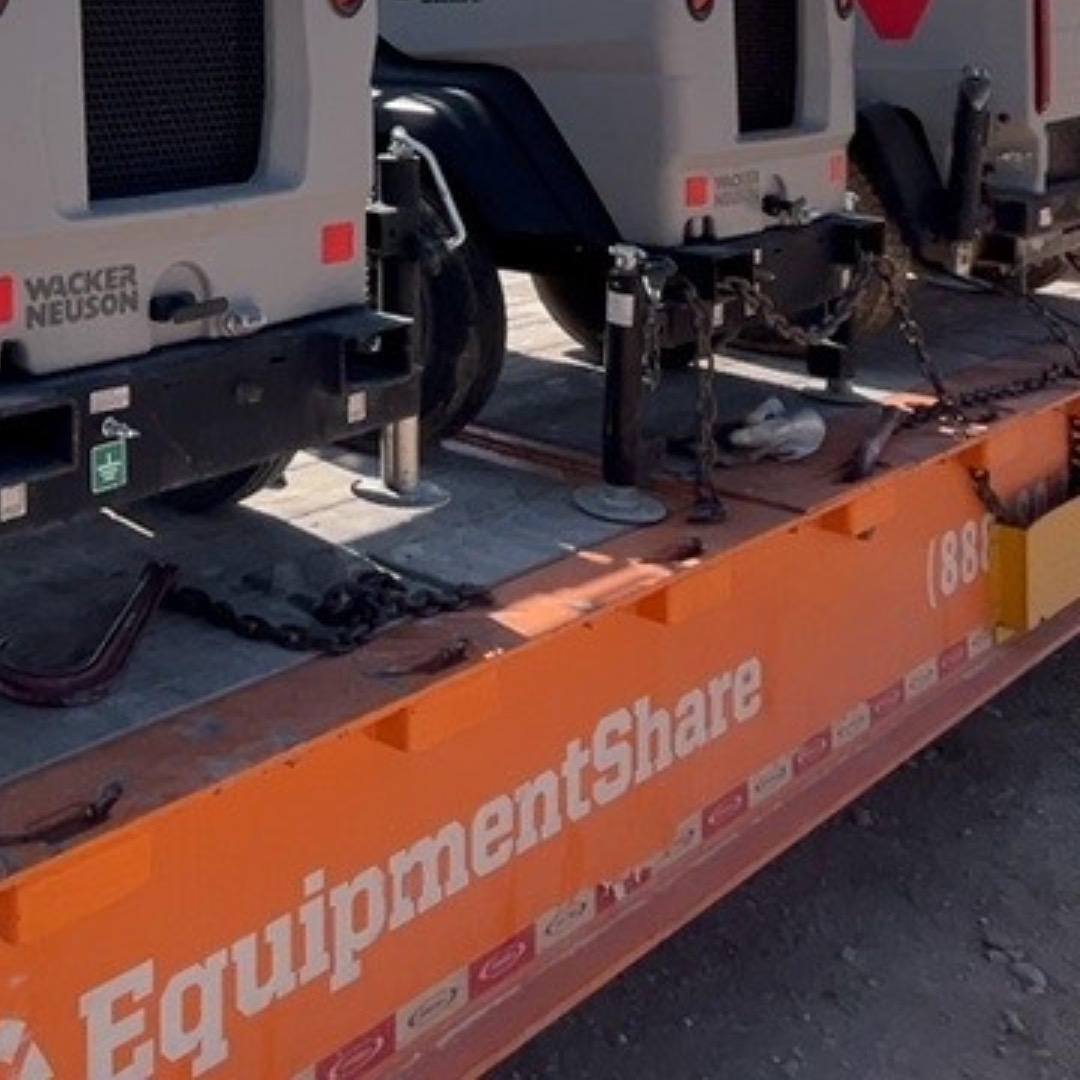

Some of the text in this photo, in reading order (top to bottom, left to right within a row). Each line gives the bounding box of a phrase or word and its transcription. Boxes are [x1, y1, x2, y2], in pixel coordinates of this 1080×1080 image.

[24, 264, 138, 302] WACKER
[25, 295, 139, 331] NEUSON
[78, 657, 762, 1080] EquipmentShare
